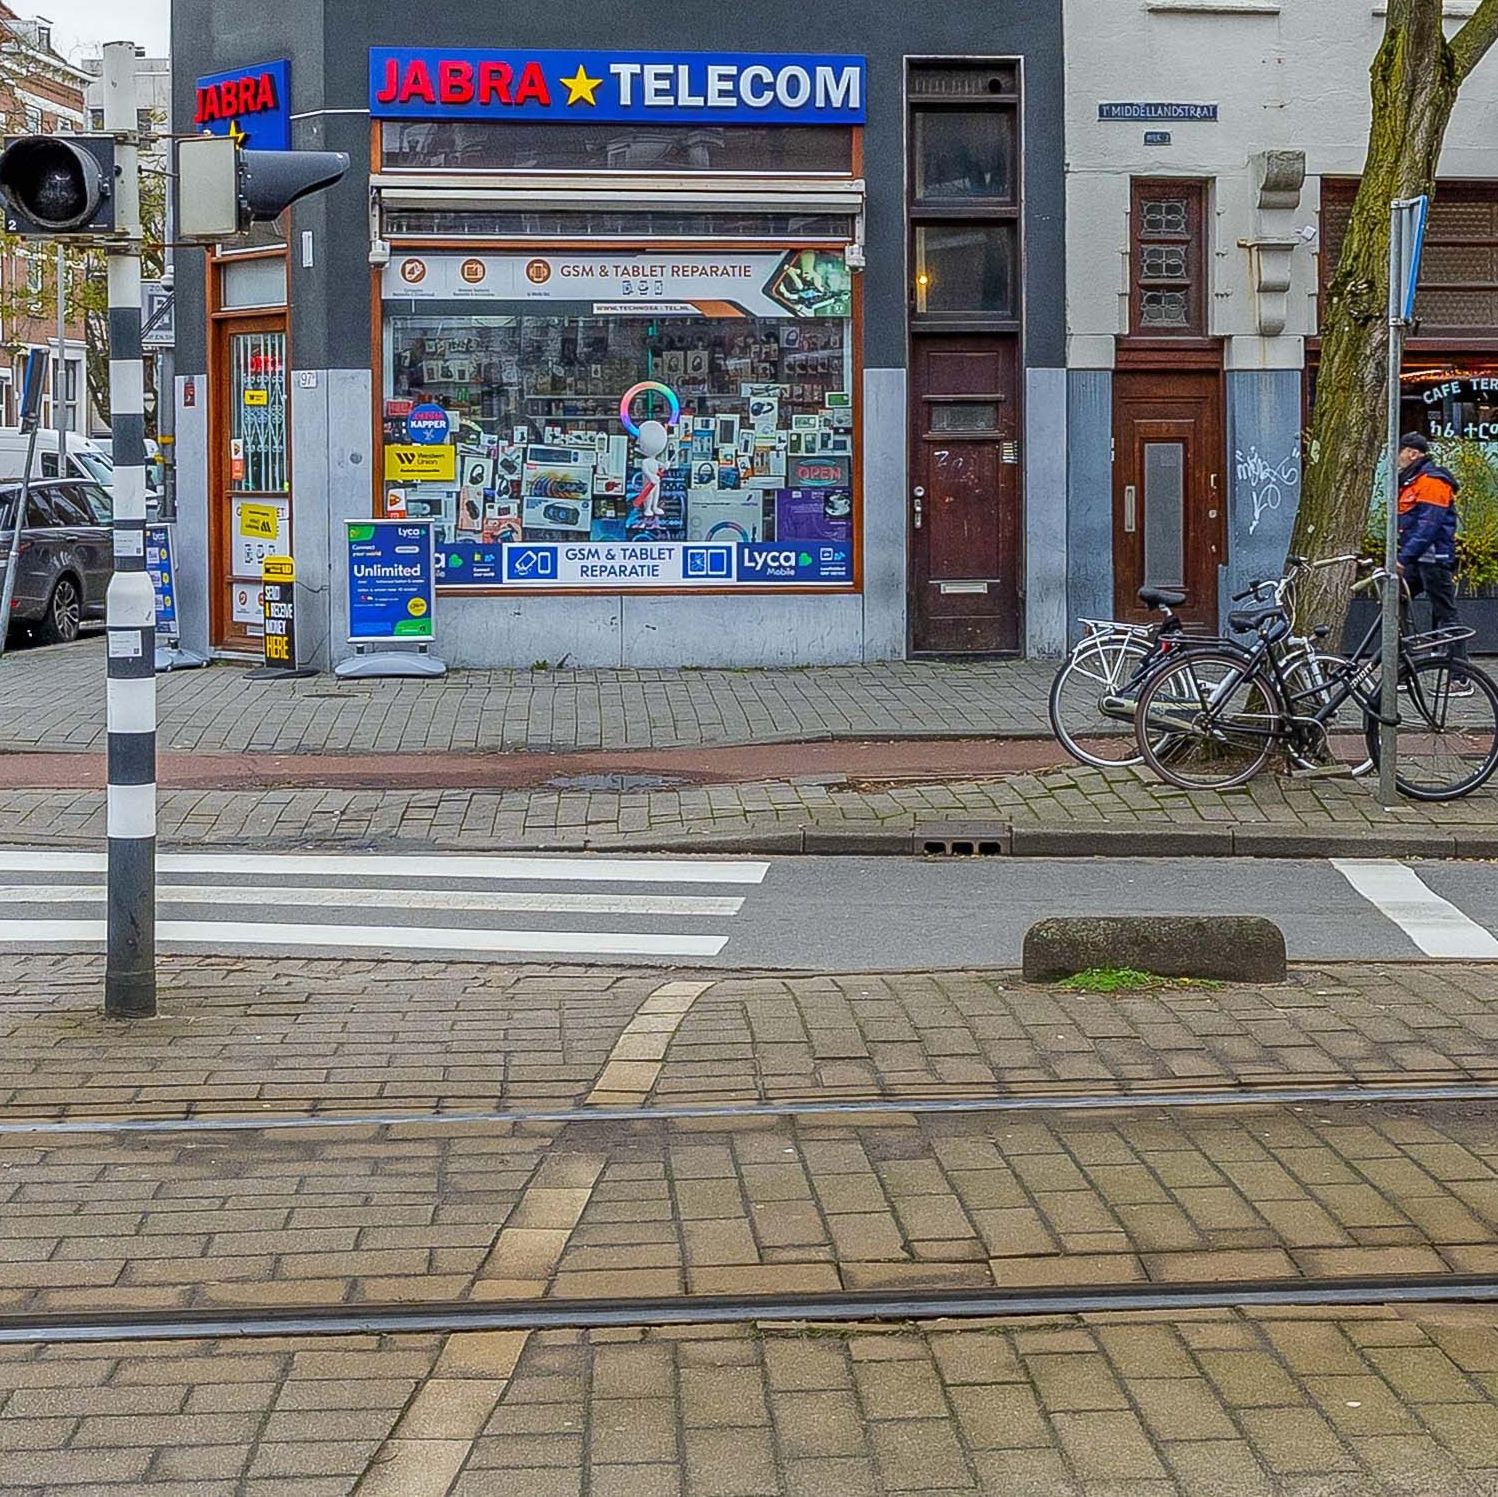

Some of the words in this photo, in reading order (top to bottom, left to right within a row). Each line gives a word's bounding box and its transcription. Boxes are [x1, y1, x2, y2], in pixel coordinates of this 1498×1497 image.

[376, 60, 552, 105] JABRA
[609, 64, 861, 109] TELECOM
[193, 73, 276, 123] JABRA
[7, 219, 17, 230] 2
[560, 265, 595, 278] GSM
[598, 265, 610, 278] &
[613, 265, 666, 278] TABLET
[670, 265, 752, 278] REPARATIE
[1423, 381, 1461, 404] CAFE
[410, 420, 446, 429] KAPPER
[797, 465, 841, 480] OPEN
[398, 527, 420, 537] Lyca
[565, 548, 603, 561] GSM
[605, 548, 617, 561] &
[620, 548, 675, 560] TABLET
[743, 548, 796, 572] Lyca
[353, 564, 421, 577] Unlimited
[579, 564, 660, 578] REPARATIE
[766, 567, 796, 576] Mobile
[266, 635, 289, 659] HERE
